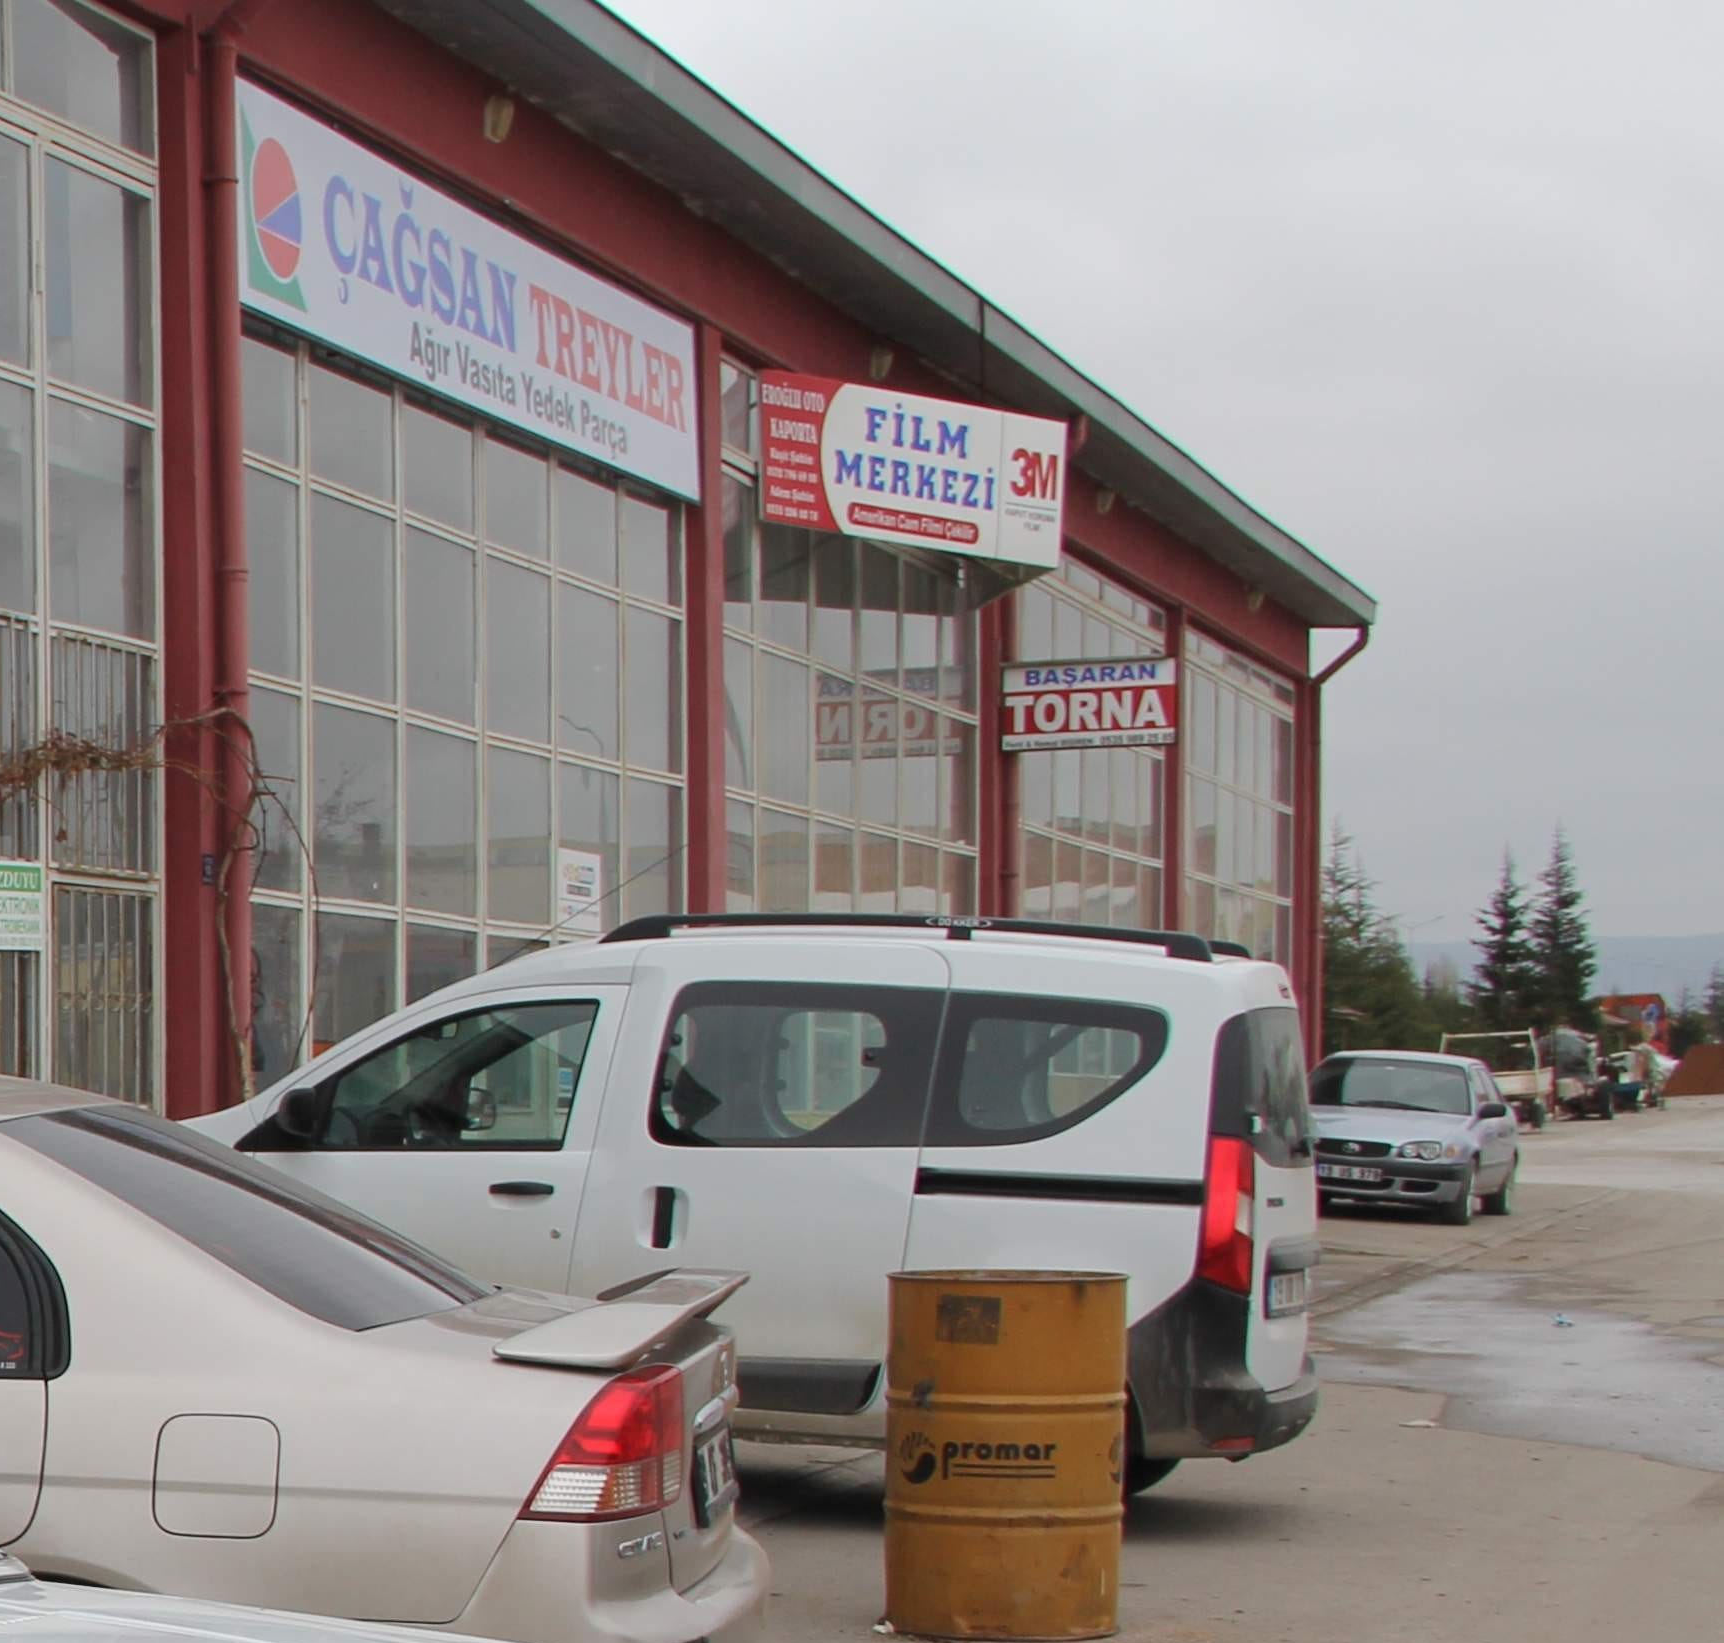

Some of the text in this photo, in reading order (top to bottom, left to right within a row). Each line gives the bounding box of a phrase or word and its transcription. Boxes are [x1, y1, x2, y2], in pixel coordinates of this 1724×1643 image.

[323, 174, 688, 433] ÇAĞSAN TREYLER
[409, 321, 628, 460] Ağır Vasıta Yedek Parça
[803, 391, 825, 413] OTO
[770, 417, 818, 445] KAPORTA
[864, 402, 968, 459] FİLM
[834, 449, 995, 510] MERKEZİ
[1010, 447, 1058, 501] 3M
[851, 505, 897, 527] Amerikan
[897, 513, 919, 531] Cam
[1025, 663, 1157, 688] BAŞARAN
[1004, 688, 1168, 734] TORNA
[942, 1441, 1057, 1480] promar
